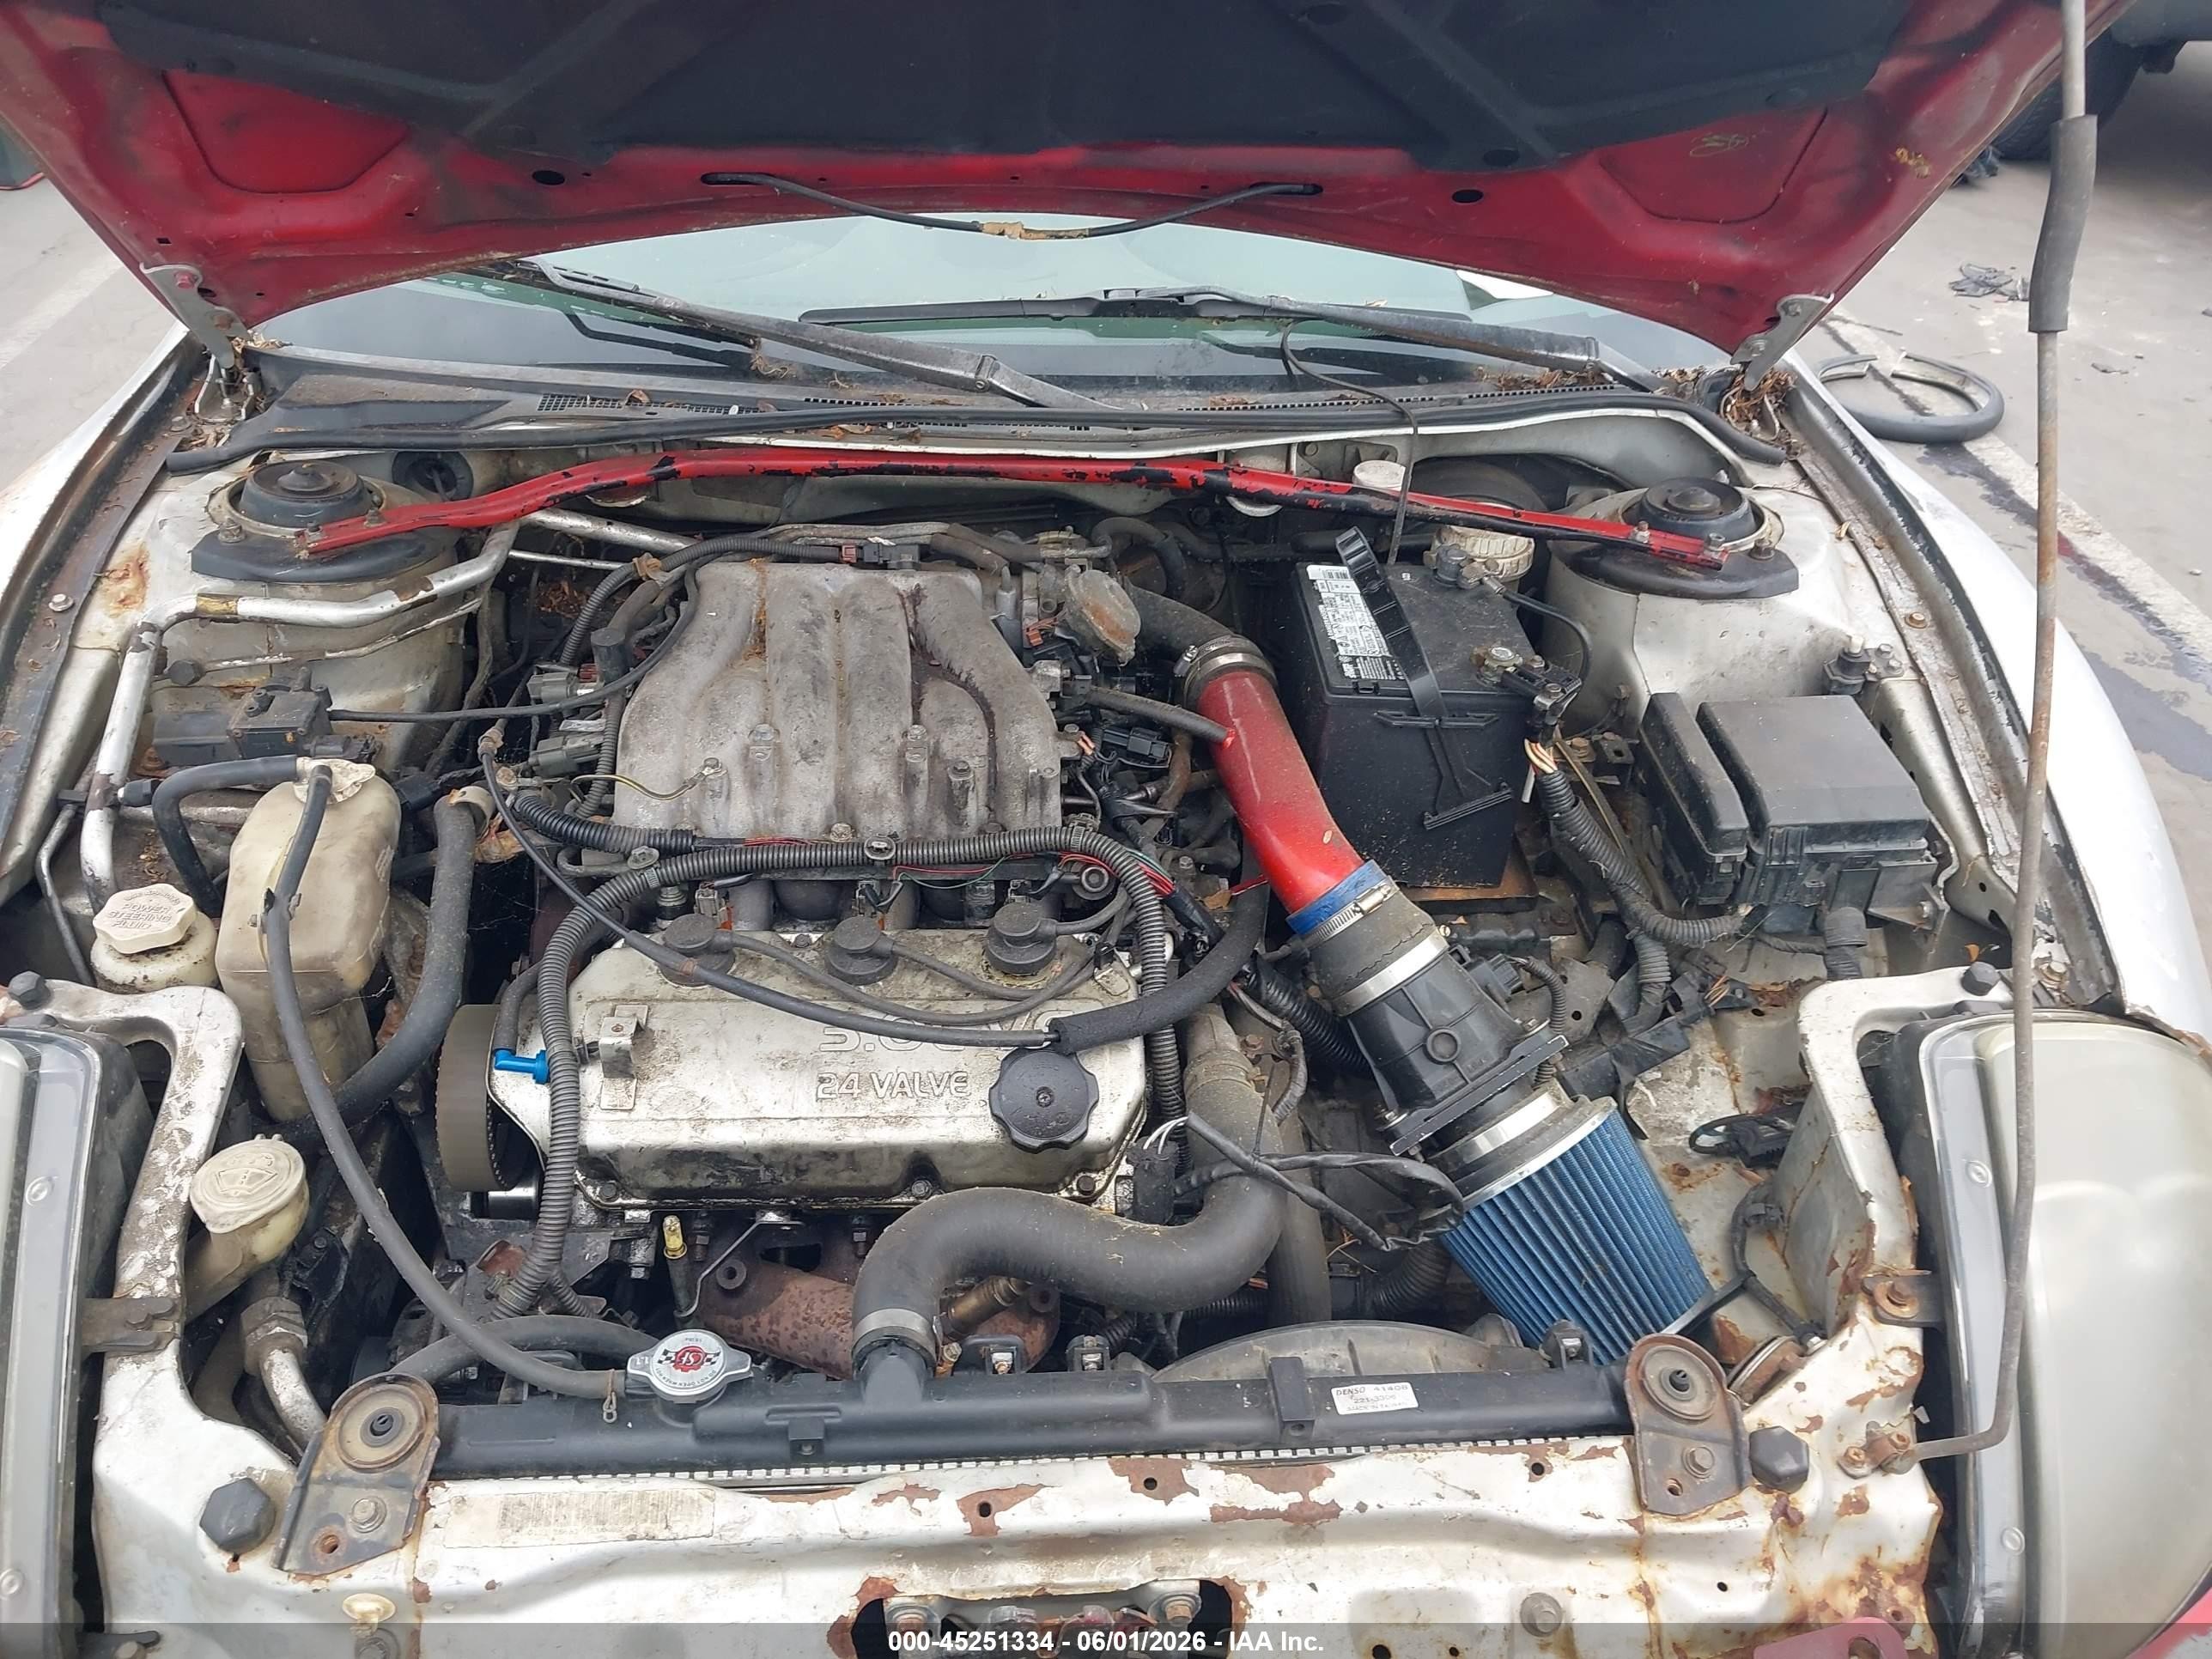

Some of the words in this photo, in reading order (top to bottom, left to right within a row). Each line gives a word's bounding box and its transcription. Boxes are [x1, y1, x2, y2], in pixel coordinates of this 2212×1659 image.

[122, 902, 171, 914] POWER
[108, 910, 173, 923] STEERING
[111, 919, 152, 930] FLUID
[817, 1072, 860, 1100] 24
[870, 1071, 971, 1099] VALVE
[1336, 1386, 1365, 1395] DENSO
